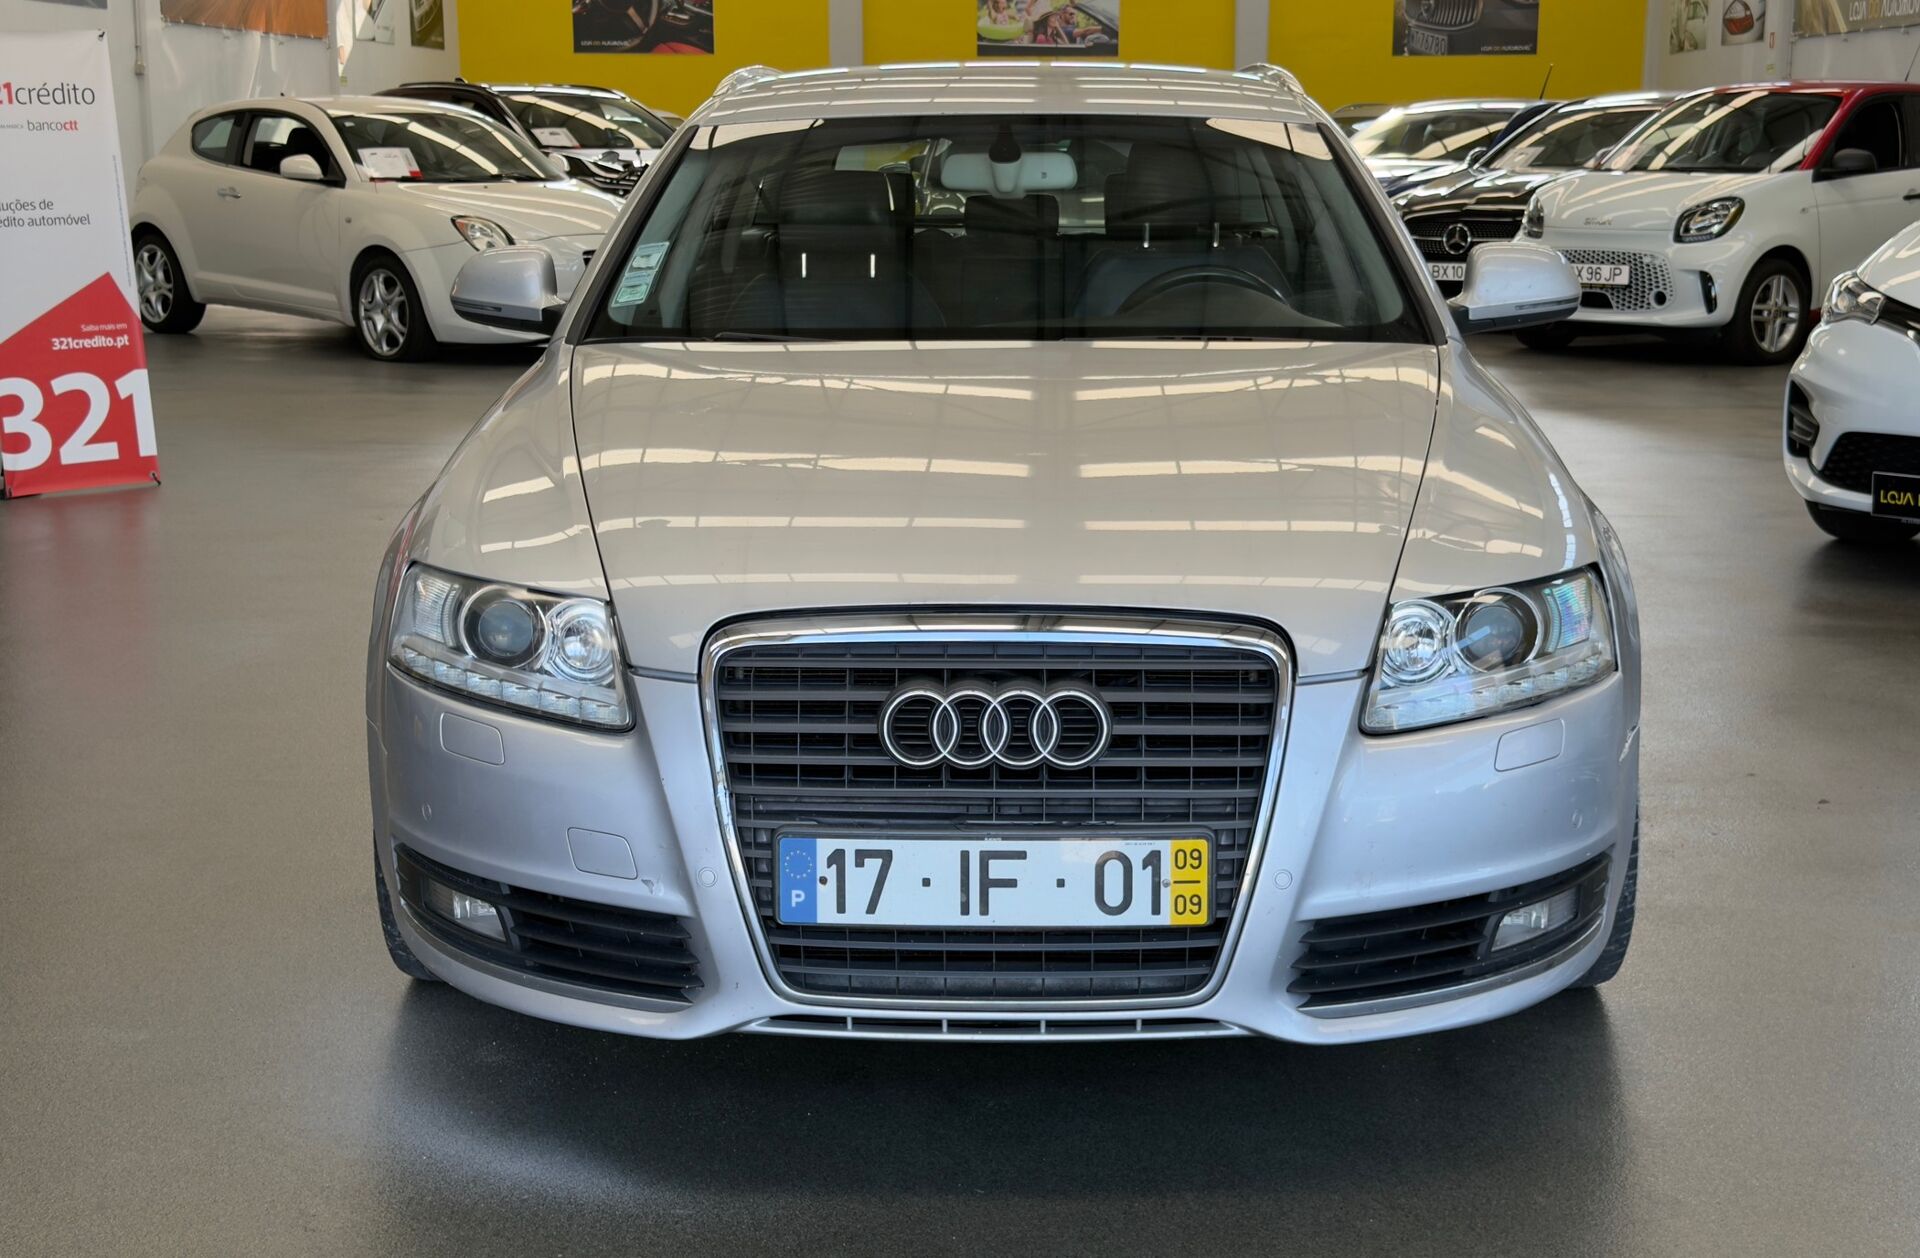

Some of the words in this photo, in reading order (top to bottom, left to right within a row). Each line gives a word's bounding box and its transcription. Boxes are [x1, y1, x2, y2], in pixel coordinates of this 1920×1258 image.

[0, 82, 95, 105] 1crédito
[27, 120, 79, 131] bancoctt
[0, 199, 37, 214] uções
[39, 199, 54, 211] de
[27, 214, 91, 227] automóvel
[1432, 265, 1449, 279] BX
[1452, 265, 1464, 279] 10
[1586, 266, 1602, 281] 96
[1604, 267, 1622, 282] JP
[52, 334, 129, 350] 321credito.pt
[0, 368, 158, 471] 321
[1880, 489, 1914, 506] LOJA
[1174, 848, 1202, 870] 09
[827, 848, 893, 914] 17
[960, 849, 1027, 916] IF
[1094, 849, 1162, 916] 01
[791, 889, 805, 907] P
[1174, 893, 1202, 916] 09
